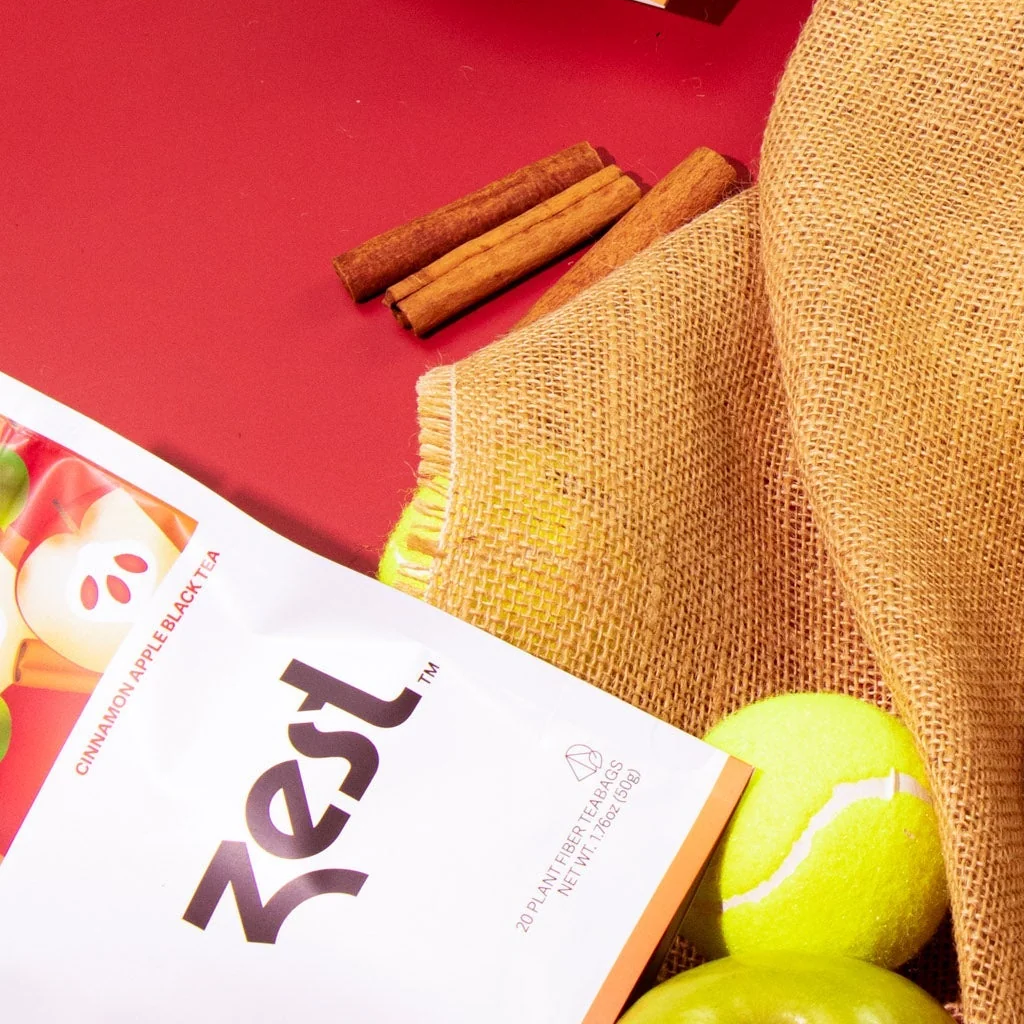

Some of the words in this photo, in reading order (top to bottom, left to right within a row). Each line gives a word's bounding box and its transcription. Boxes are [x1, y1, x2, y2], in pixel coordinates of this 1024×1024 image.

[75, 682, 135, 777] CINNAMON
[128, 630, 168, 683] APPLE
[160, 581, 202, 632] BLACK
[194, 549, 221, 579] TEA
[182, 658, 423, 945] zest
[515, 913, 534, 933] 20
[526, 864, 561, 914] PLANT
[554, 824, 587, 866] FIBER
[577, 759, 624, 825] TEABAGS
[557, 867, 581, 897] NET
[574, 843, 598, 867] WT.
[589, 803, 621, 842] 1.76oz
[612, 767, 642, 804] (50g)
